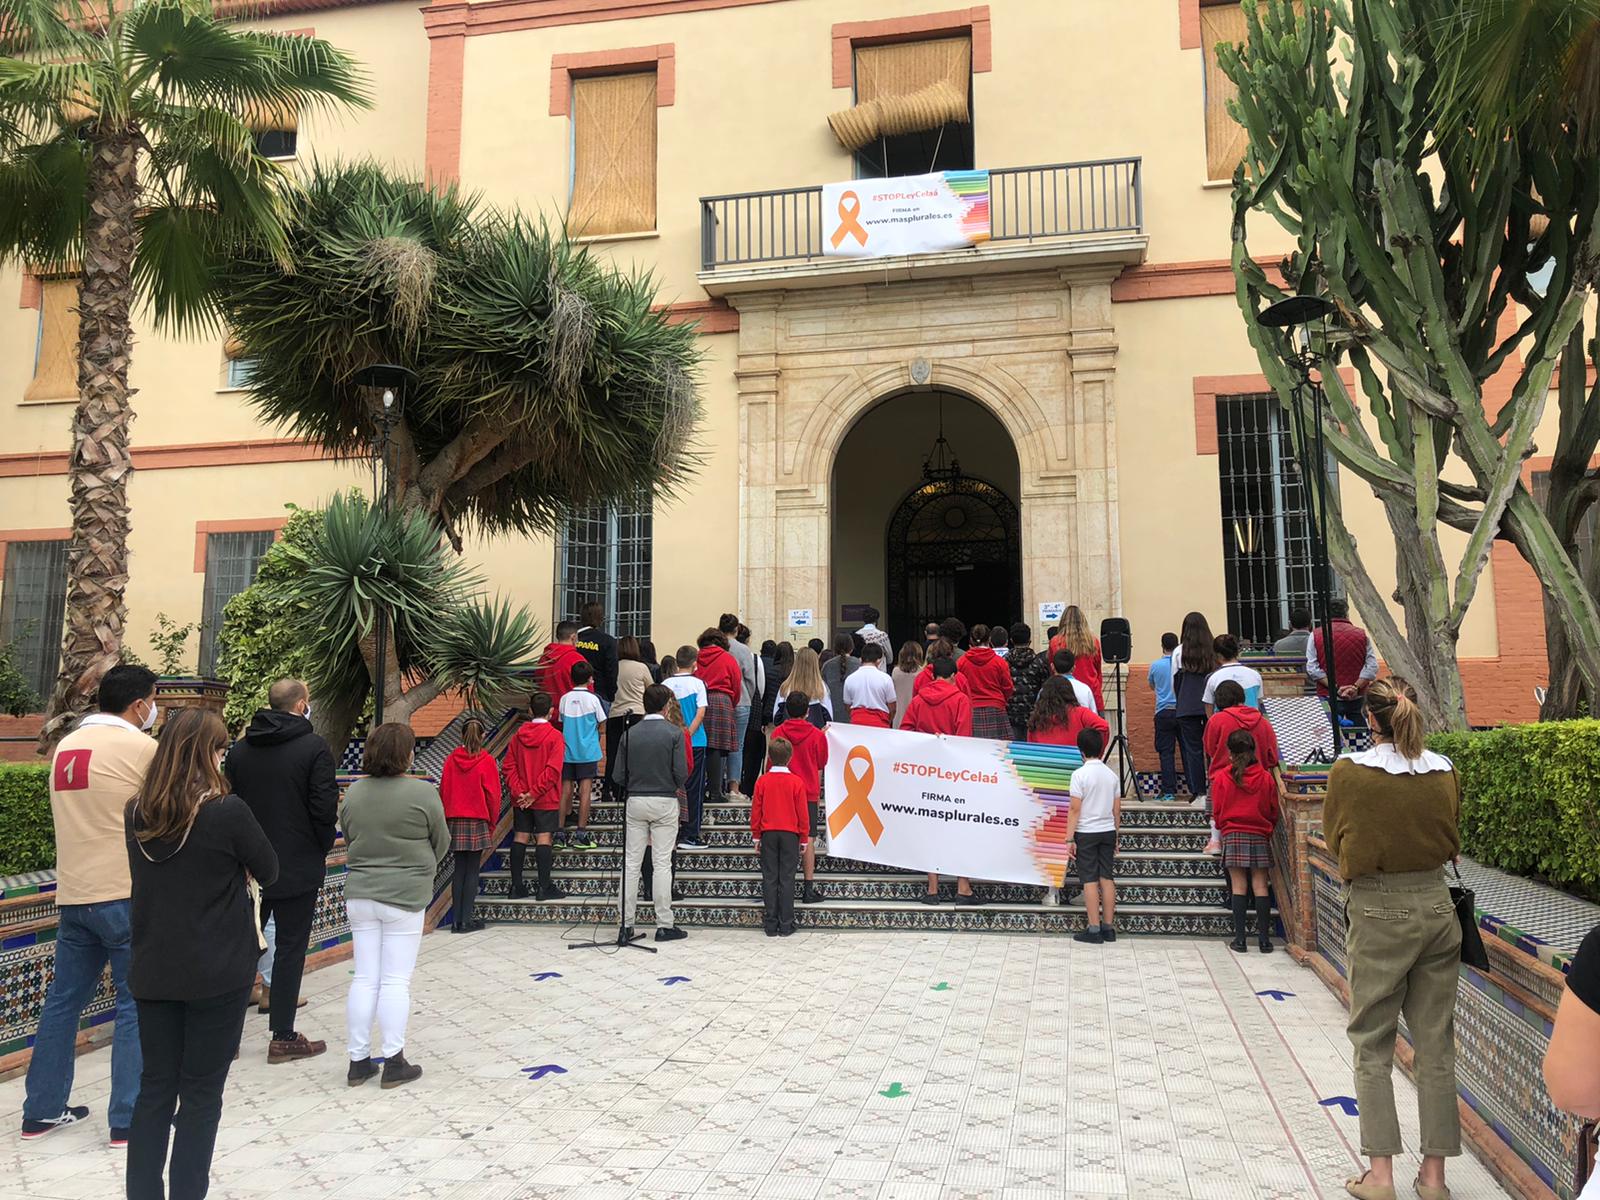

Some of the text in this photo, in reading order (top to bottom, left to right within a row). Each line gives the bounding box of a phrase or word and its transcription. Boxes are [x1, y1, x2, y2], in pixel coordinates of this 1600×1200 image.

[872, 189, 938, 202] #STOPLeyCelaá
[866, 213, 953, 225] www.masplurales.es
[893, 761, 998, 784] #STOPLeyCelaá
[921, 791, 951, 803] FIRMA
[881, 802, 1020, 826] www.masplurales.es
